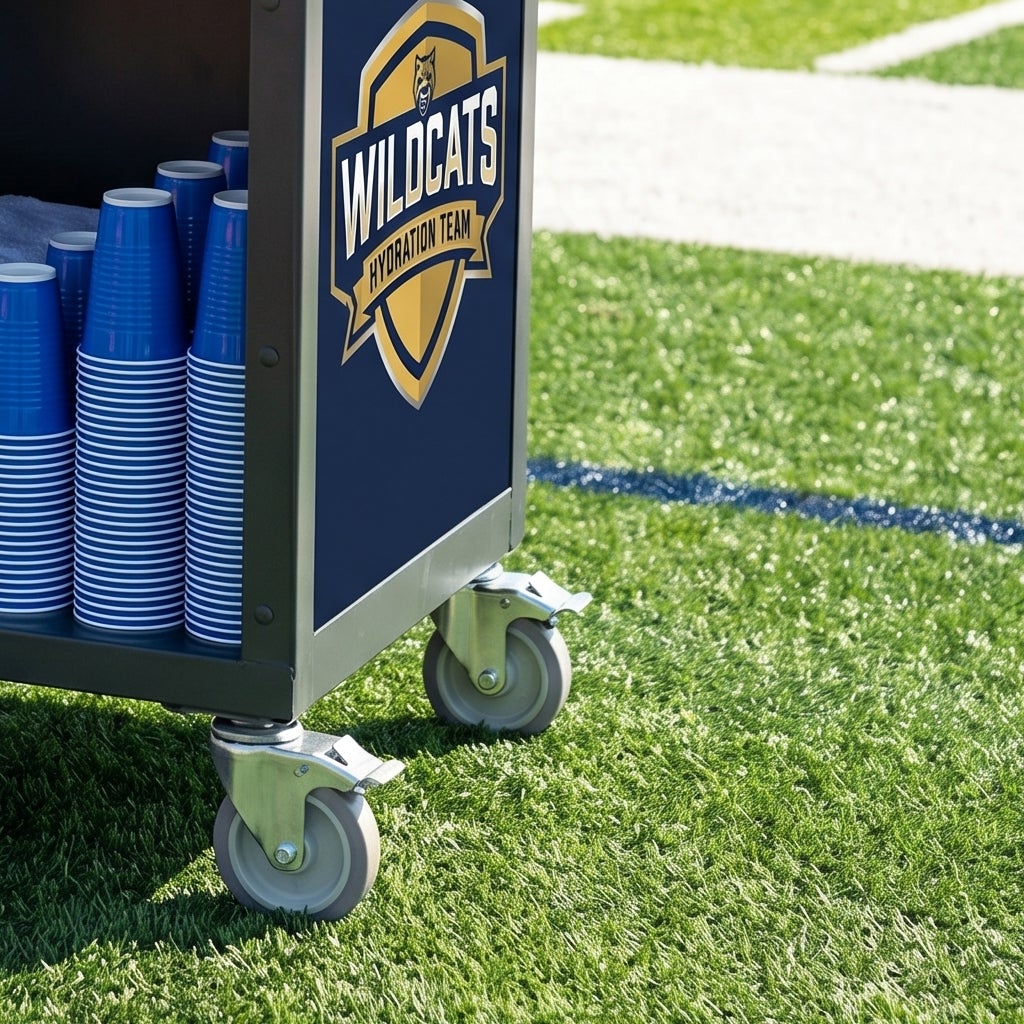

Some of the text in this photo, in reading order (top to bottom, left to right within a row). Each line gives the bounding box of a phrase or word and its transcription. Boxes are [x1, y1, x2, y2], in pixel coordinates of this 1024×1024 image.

[341, 85, 498, 261] WILDCATS
[369, 209, 471, 294] HYDRATION TEAM
